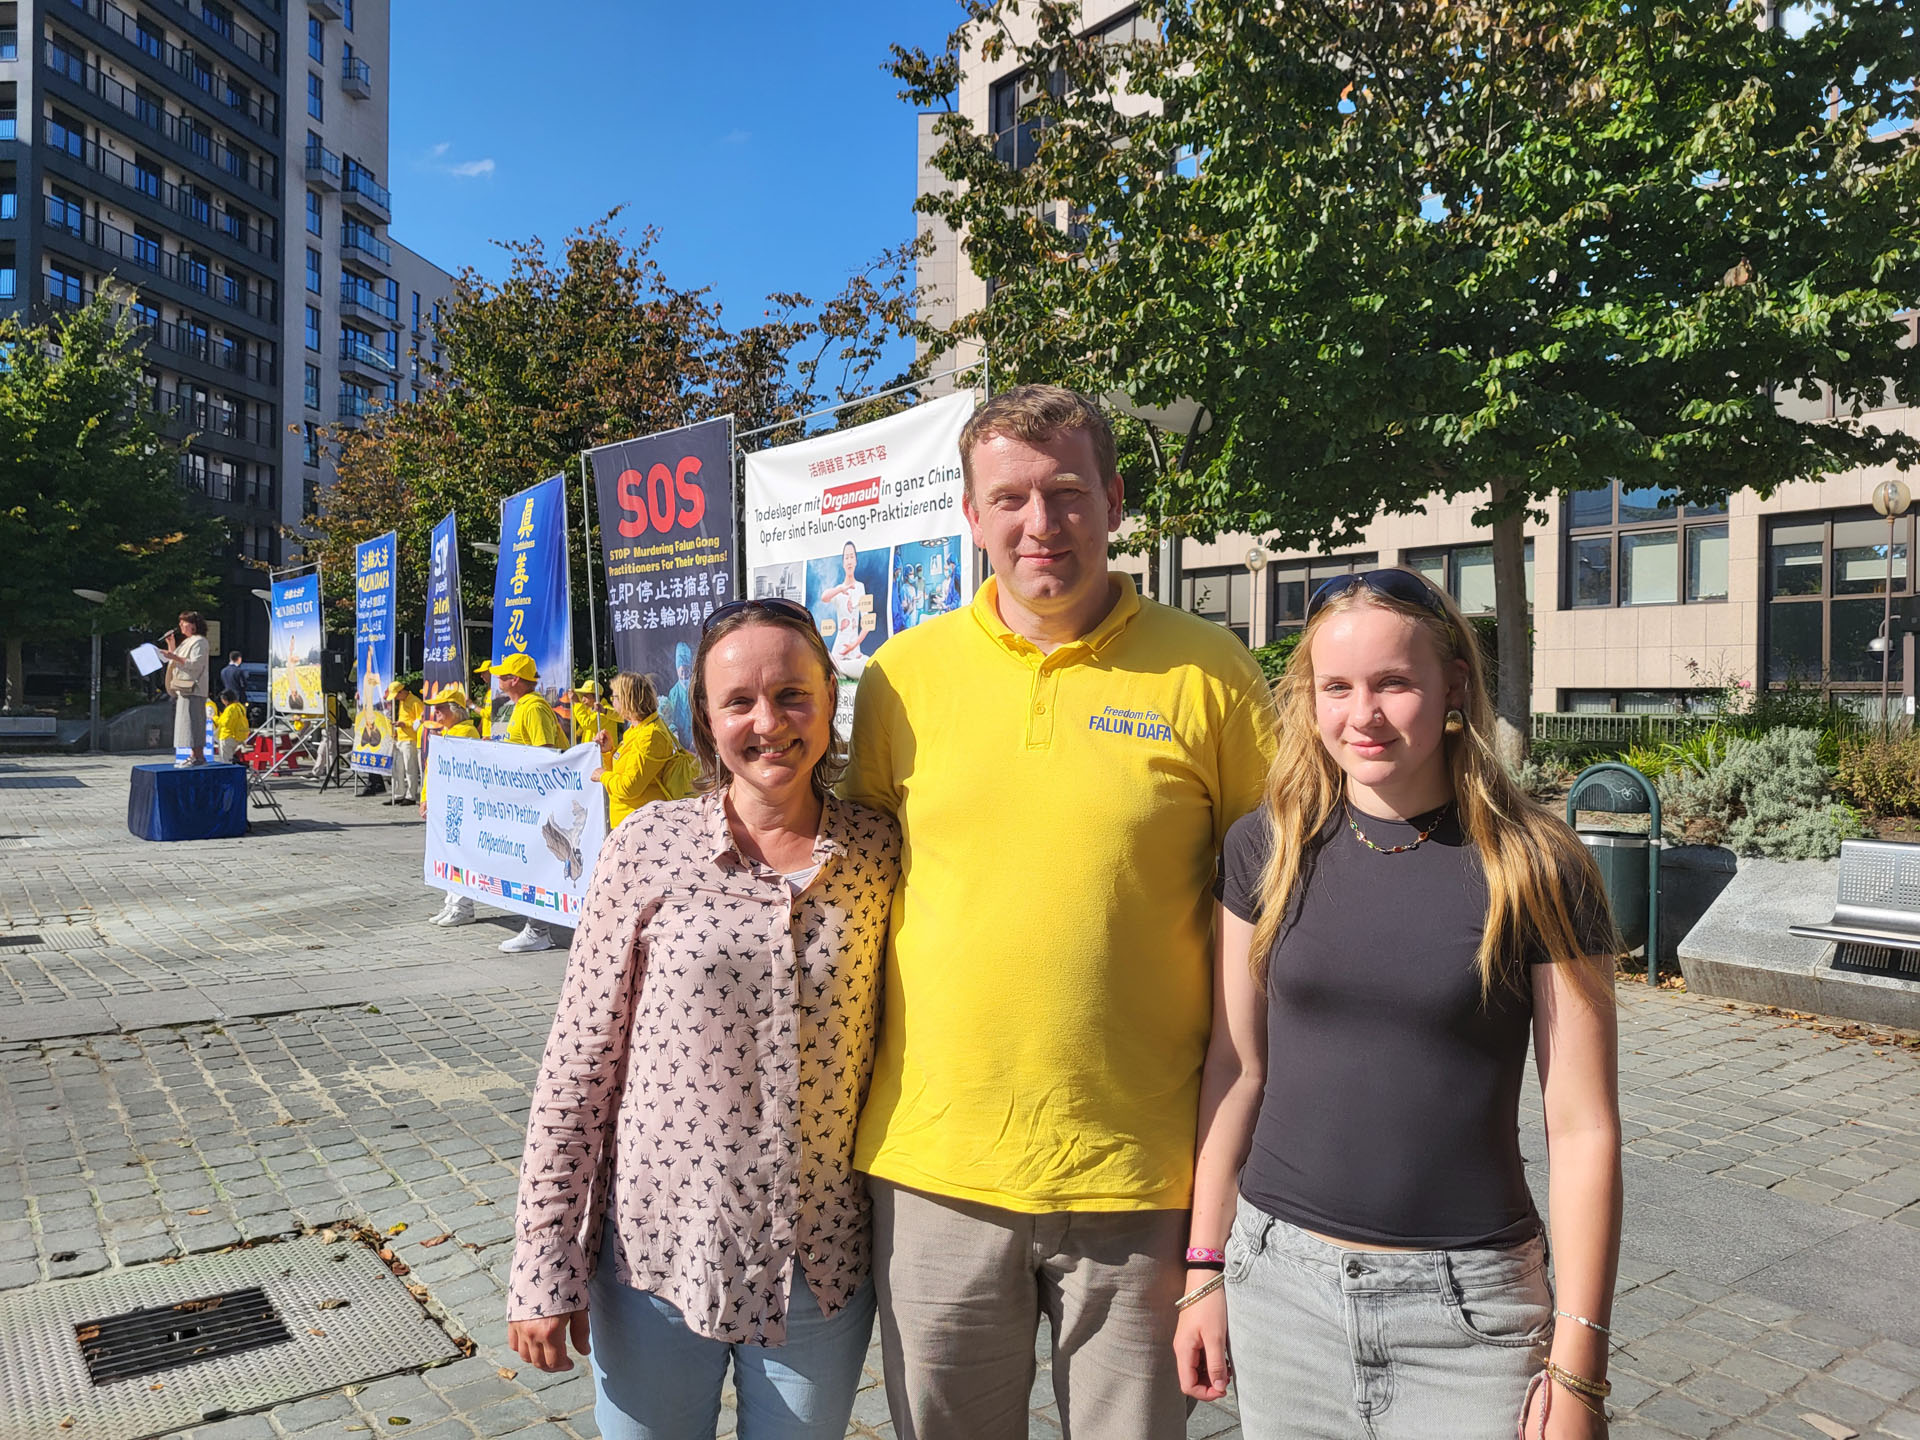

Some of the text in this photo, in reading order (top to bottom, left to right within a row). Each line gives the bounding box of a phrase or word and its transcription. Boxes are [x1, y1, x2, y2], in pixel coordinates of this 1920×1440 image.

[845, 445, 888, 468] 天理不容
[617, 455, 705, 538] SOS
[754, 465, 961, 523] Todeslager mit Organraub in ganz China
[759, 492, 954, 545] Opfer sind Falun-Gong-Praktizierende
[608, 549, 728, 577] Practitioners For Their Organs!
[610, 536, 720, 561] STOP Murdering Falun Gong
[510, 552, 530, 596] 善
[609, 570, 729, 606] 立即停止活摘器官
[504, 609, 528, 653] 忍
[614, 600, 723, 632] 虐殺法輪功學員
[1089, 715, 1172, 742] FALUN DAFA
[1103, 705, 1160, 721] Freedom For
[438, 754, 583, 796] Stop Forced Organ Harvesting in China
[473, 797, 541, 826] Sign the G7+7 Petition
[477, 830, 528, 864] FOHpetition.org
